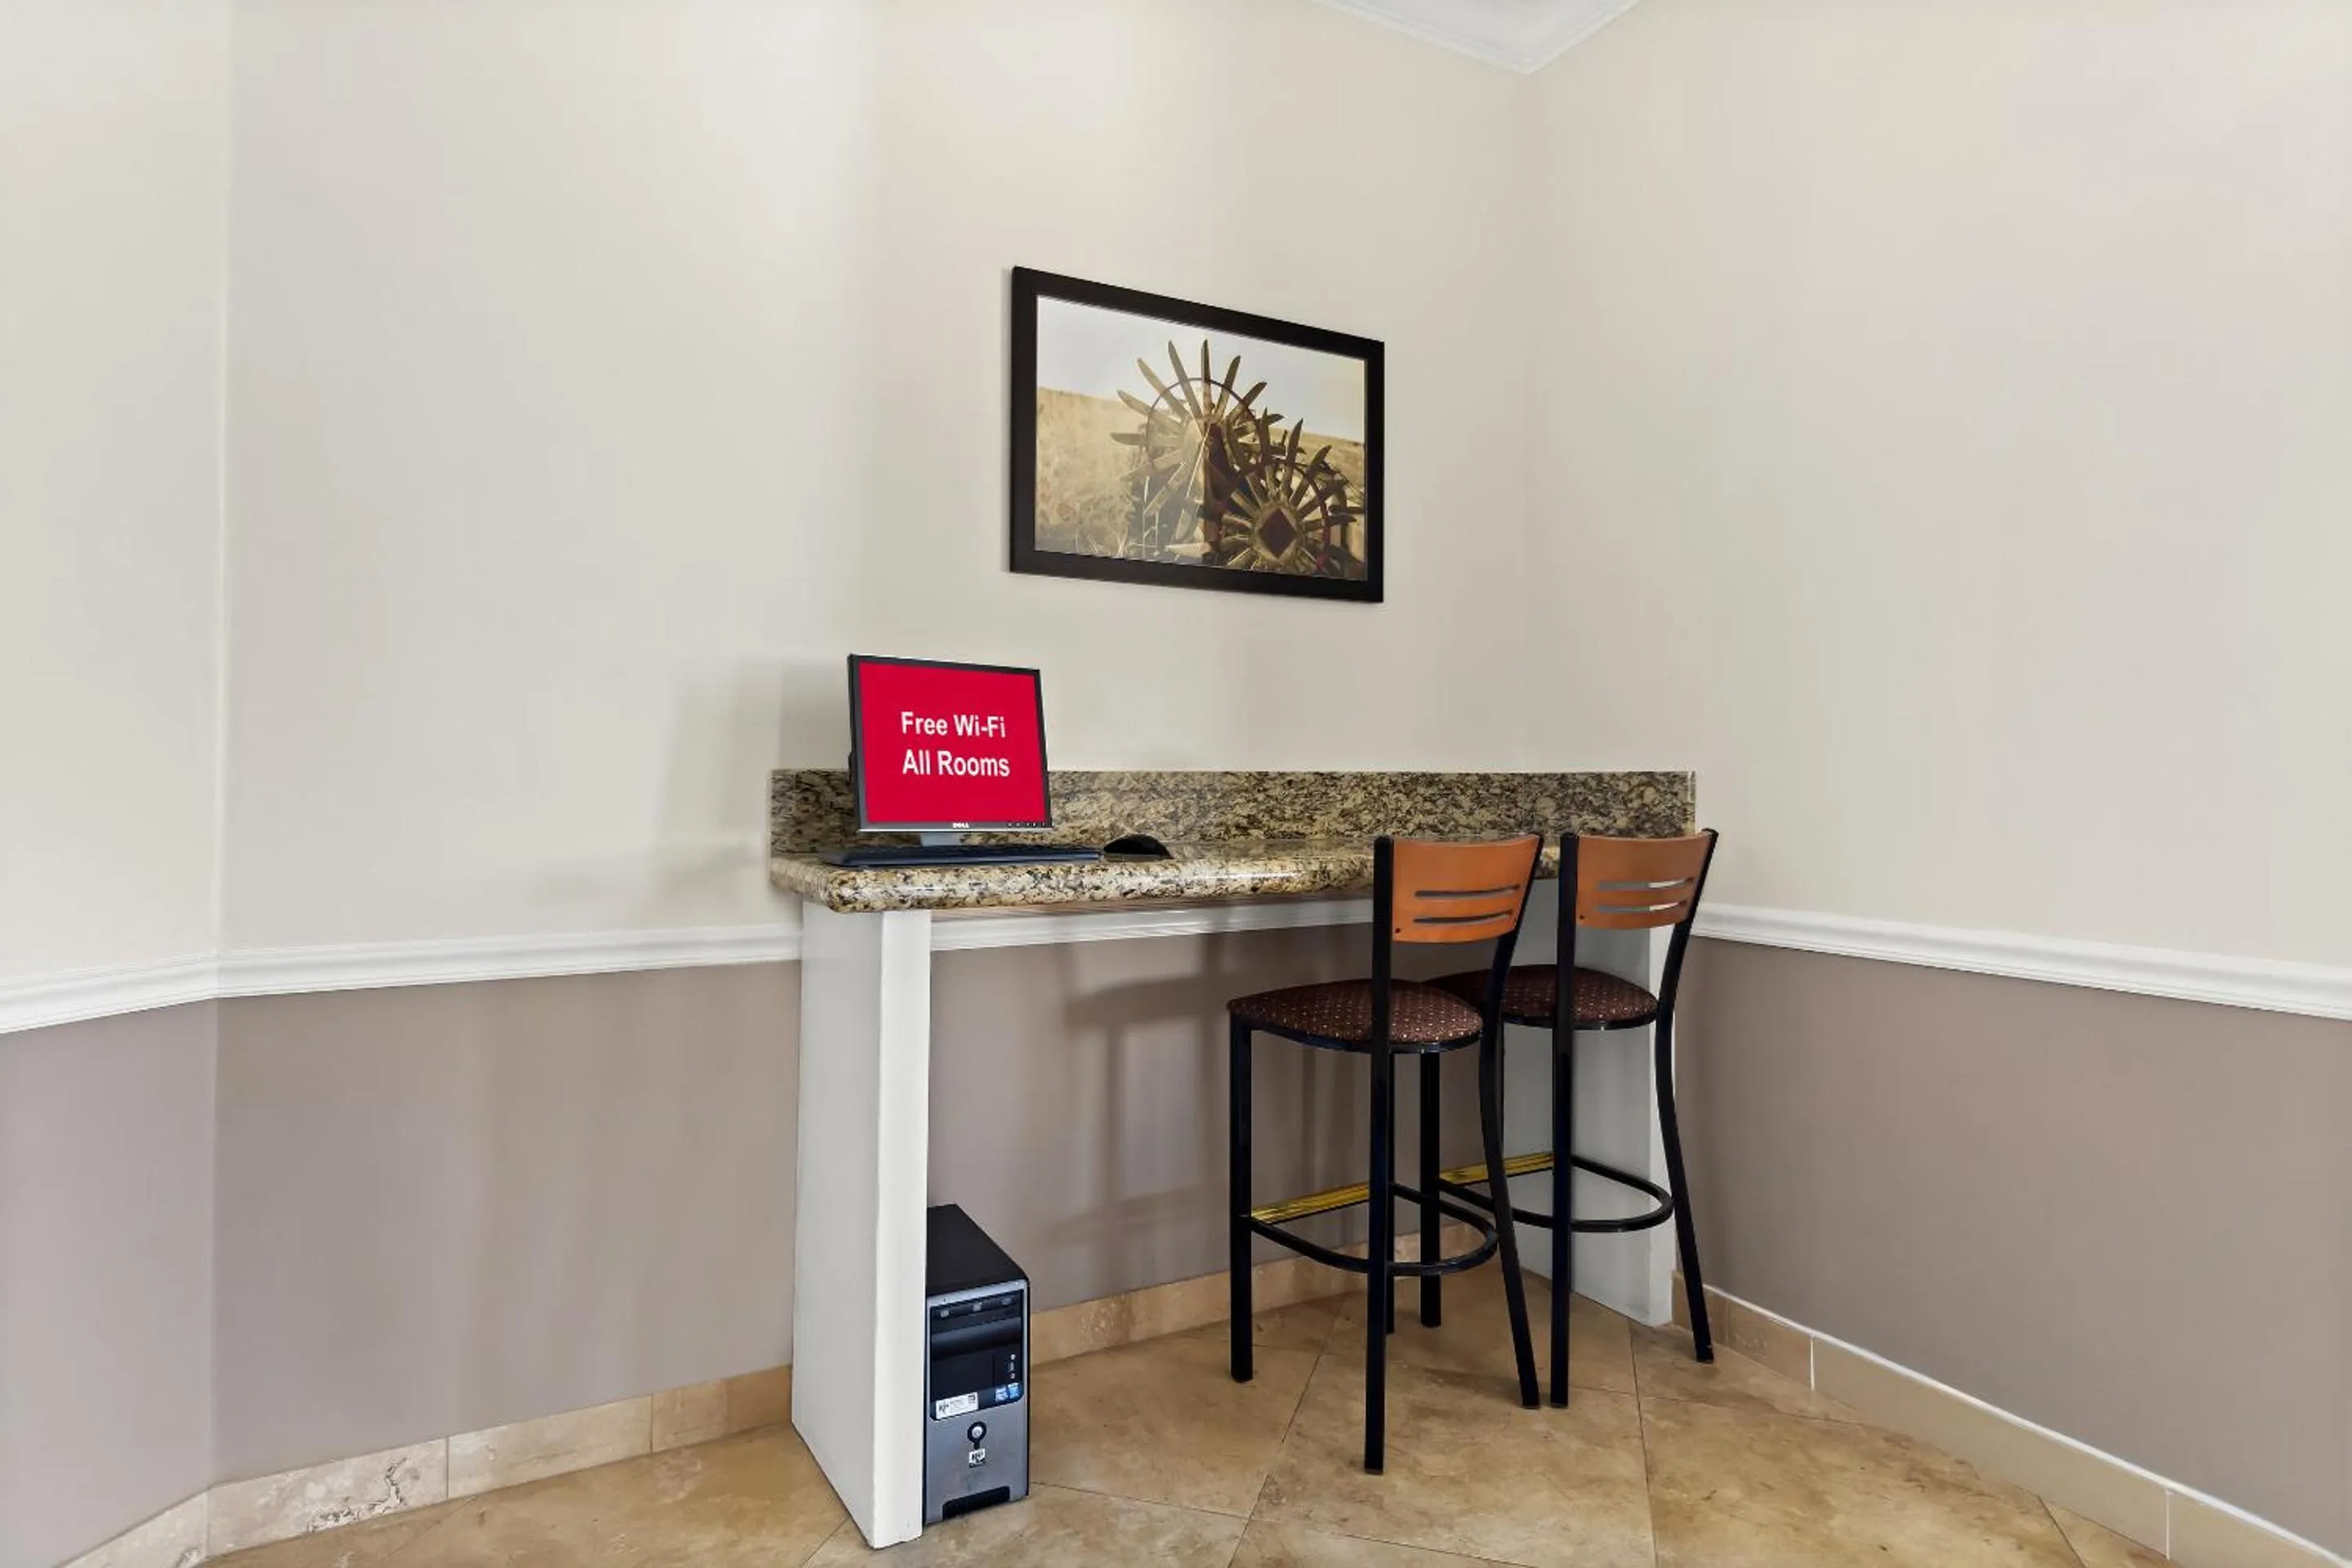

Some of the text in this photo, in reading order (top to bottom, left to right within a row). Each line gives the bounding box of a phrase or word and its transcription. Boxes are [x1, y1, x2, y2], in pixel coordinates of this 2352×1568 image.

[901, 711, 1006, 738] Free Wi-Fi
[902, 749, 1010, 777] All Rooms
